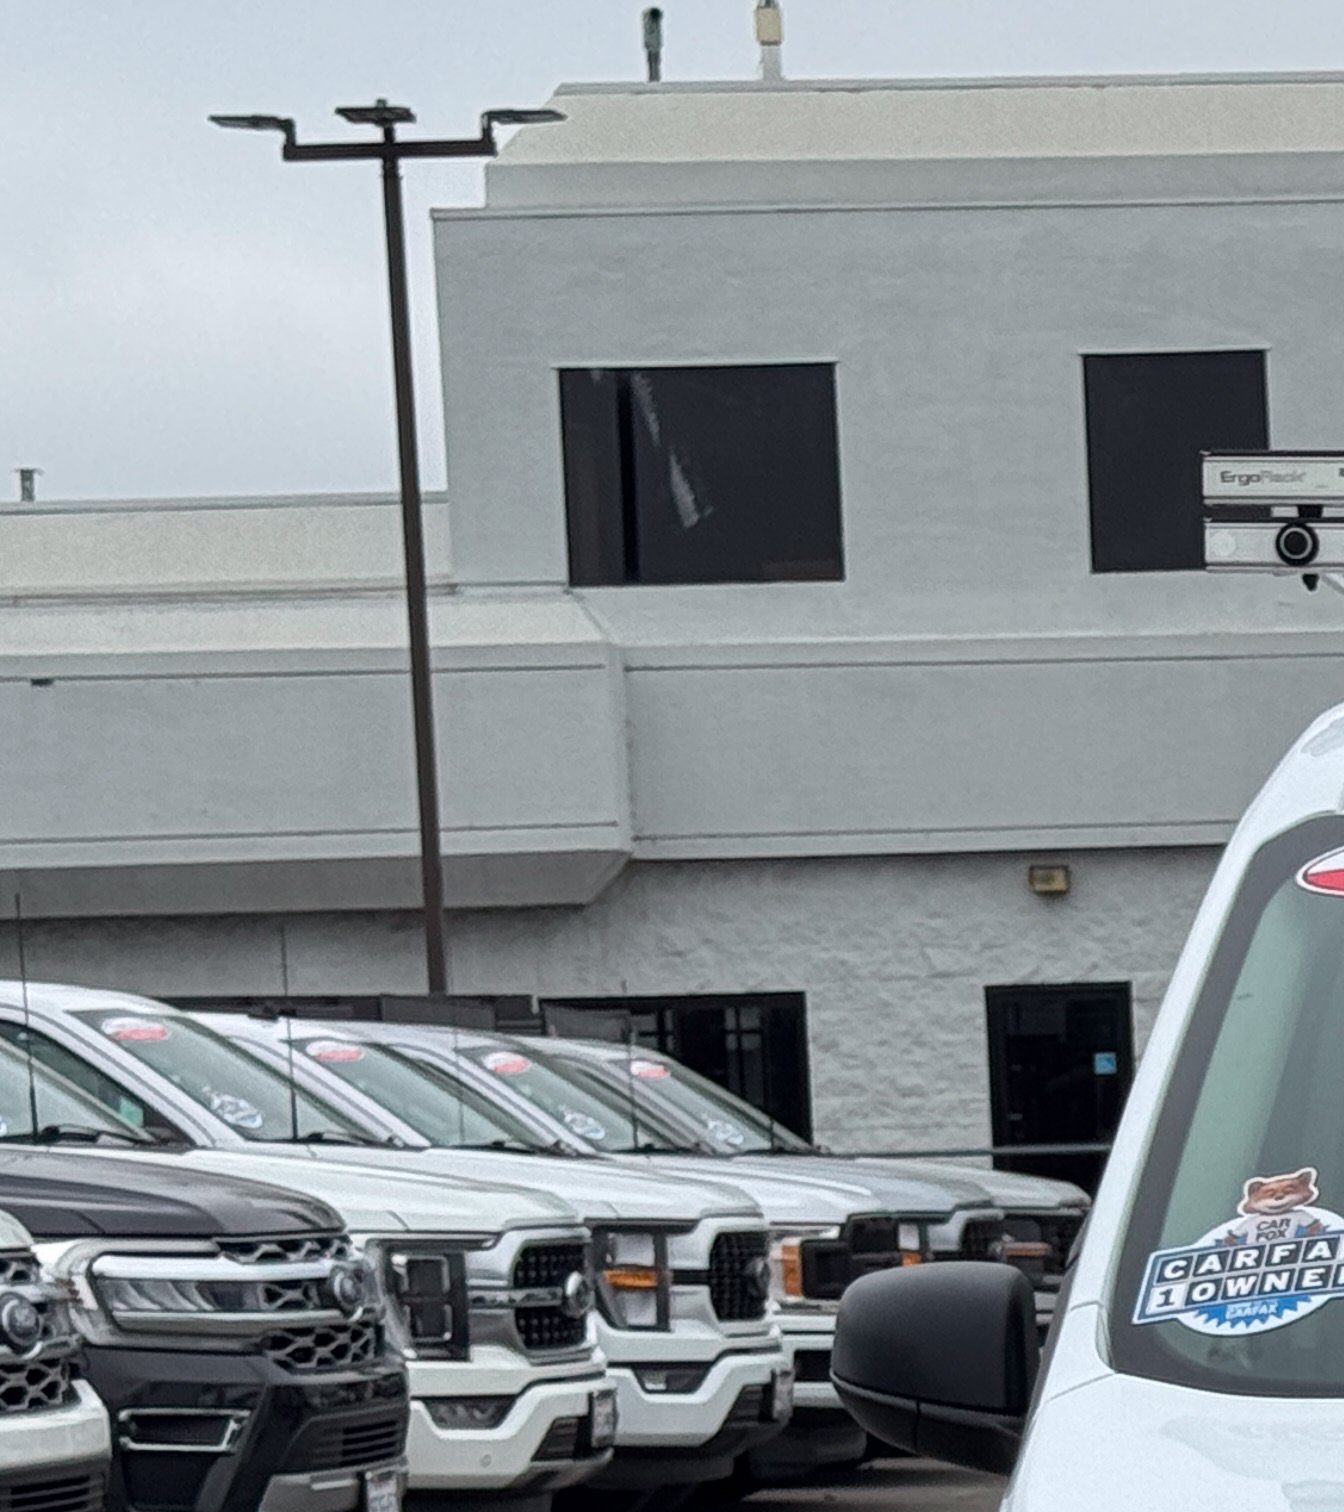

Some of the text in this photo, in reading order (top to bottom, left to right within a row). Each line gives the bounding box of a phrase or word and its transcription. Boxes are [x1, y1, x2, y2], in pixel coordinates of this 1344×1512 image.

[1256, 1218, 1292, 1231] CAR
[1256, 1229, 1287, 1243] FOX
[1156, 1287, 1178, 1309] 1
